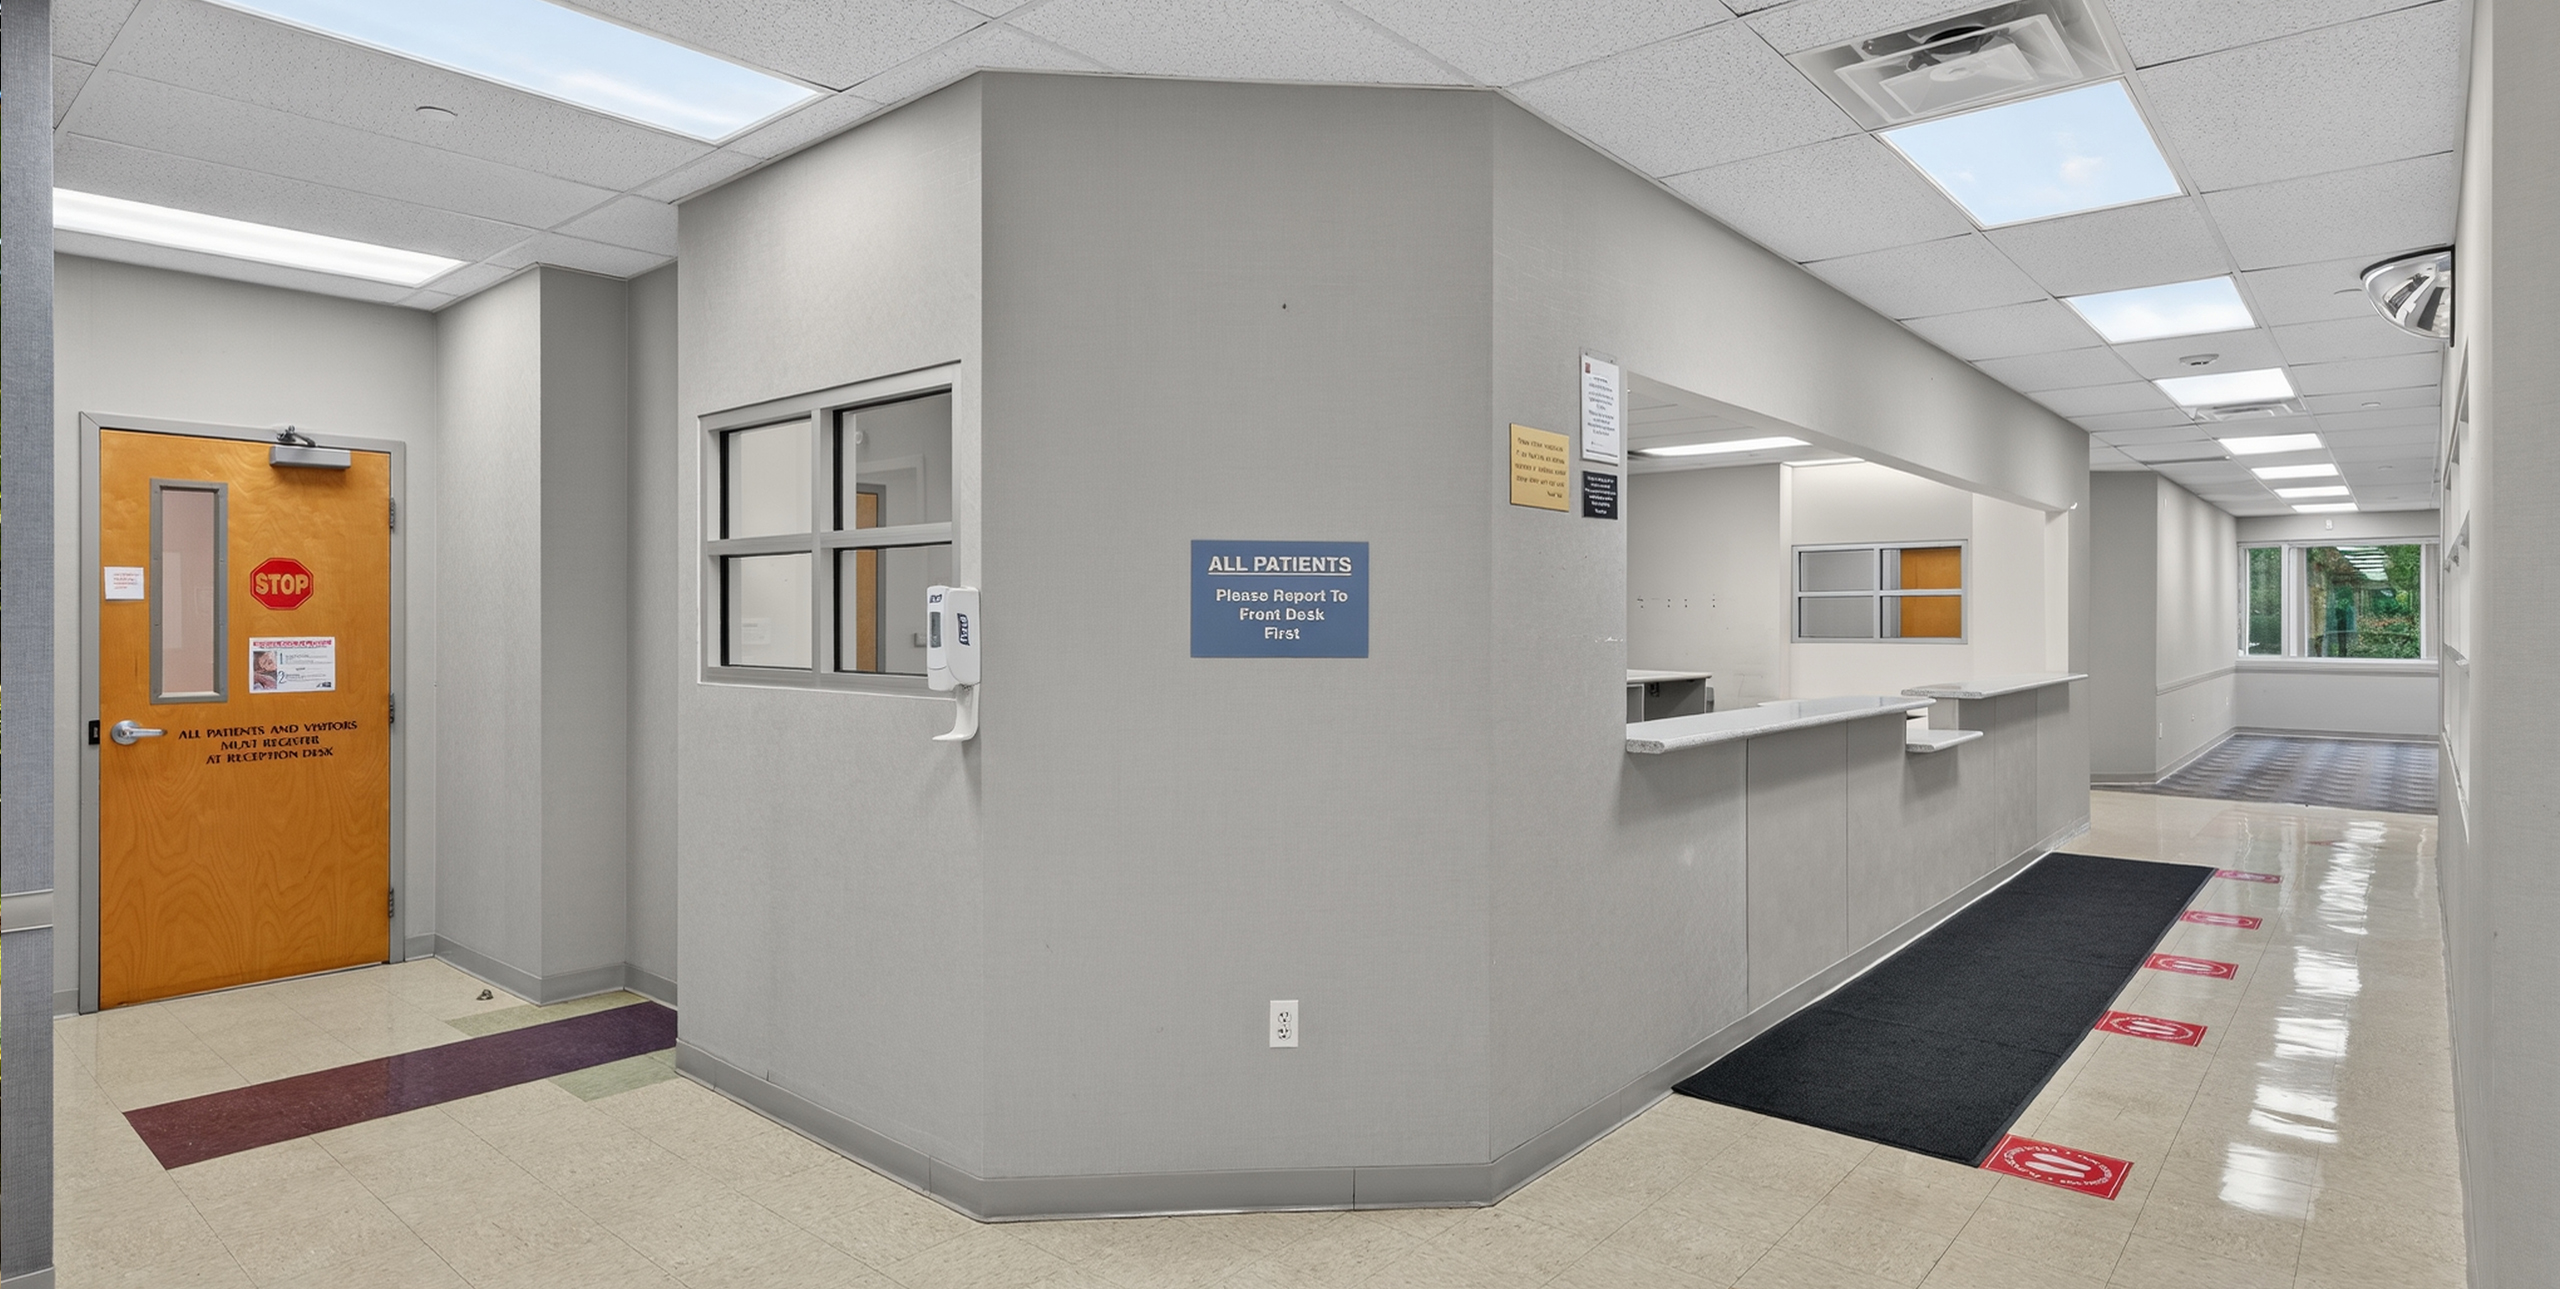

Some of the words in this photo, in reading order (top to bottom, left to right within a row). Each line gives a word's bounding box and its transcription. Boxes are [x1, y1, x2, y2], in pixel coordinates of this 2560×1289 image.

[1208, 556, 1248, 572] ALL
[1253, 556, 1352, 573] PATIENTS
[255, 572, 309, 595] STOP
[1216, 588, 1269, 602] Please
[1273, 589, 1326, 604] Report
[1330, 589, 1348, 602] To
[1240, 608, 1281, 621] Front
[1285, 608, 1325, 621] Desk
[1265, 627, 1300, 639] First
[178, 730, 201, 740] ALL
[206, 726, 265, 738] PATIENTS
[270, 724, 299, 734] AND
[206, 754, 221, 764] AT
